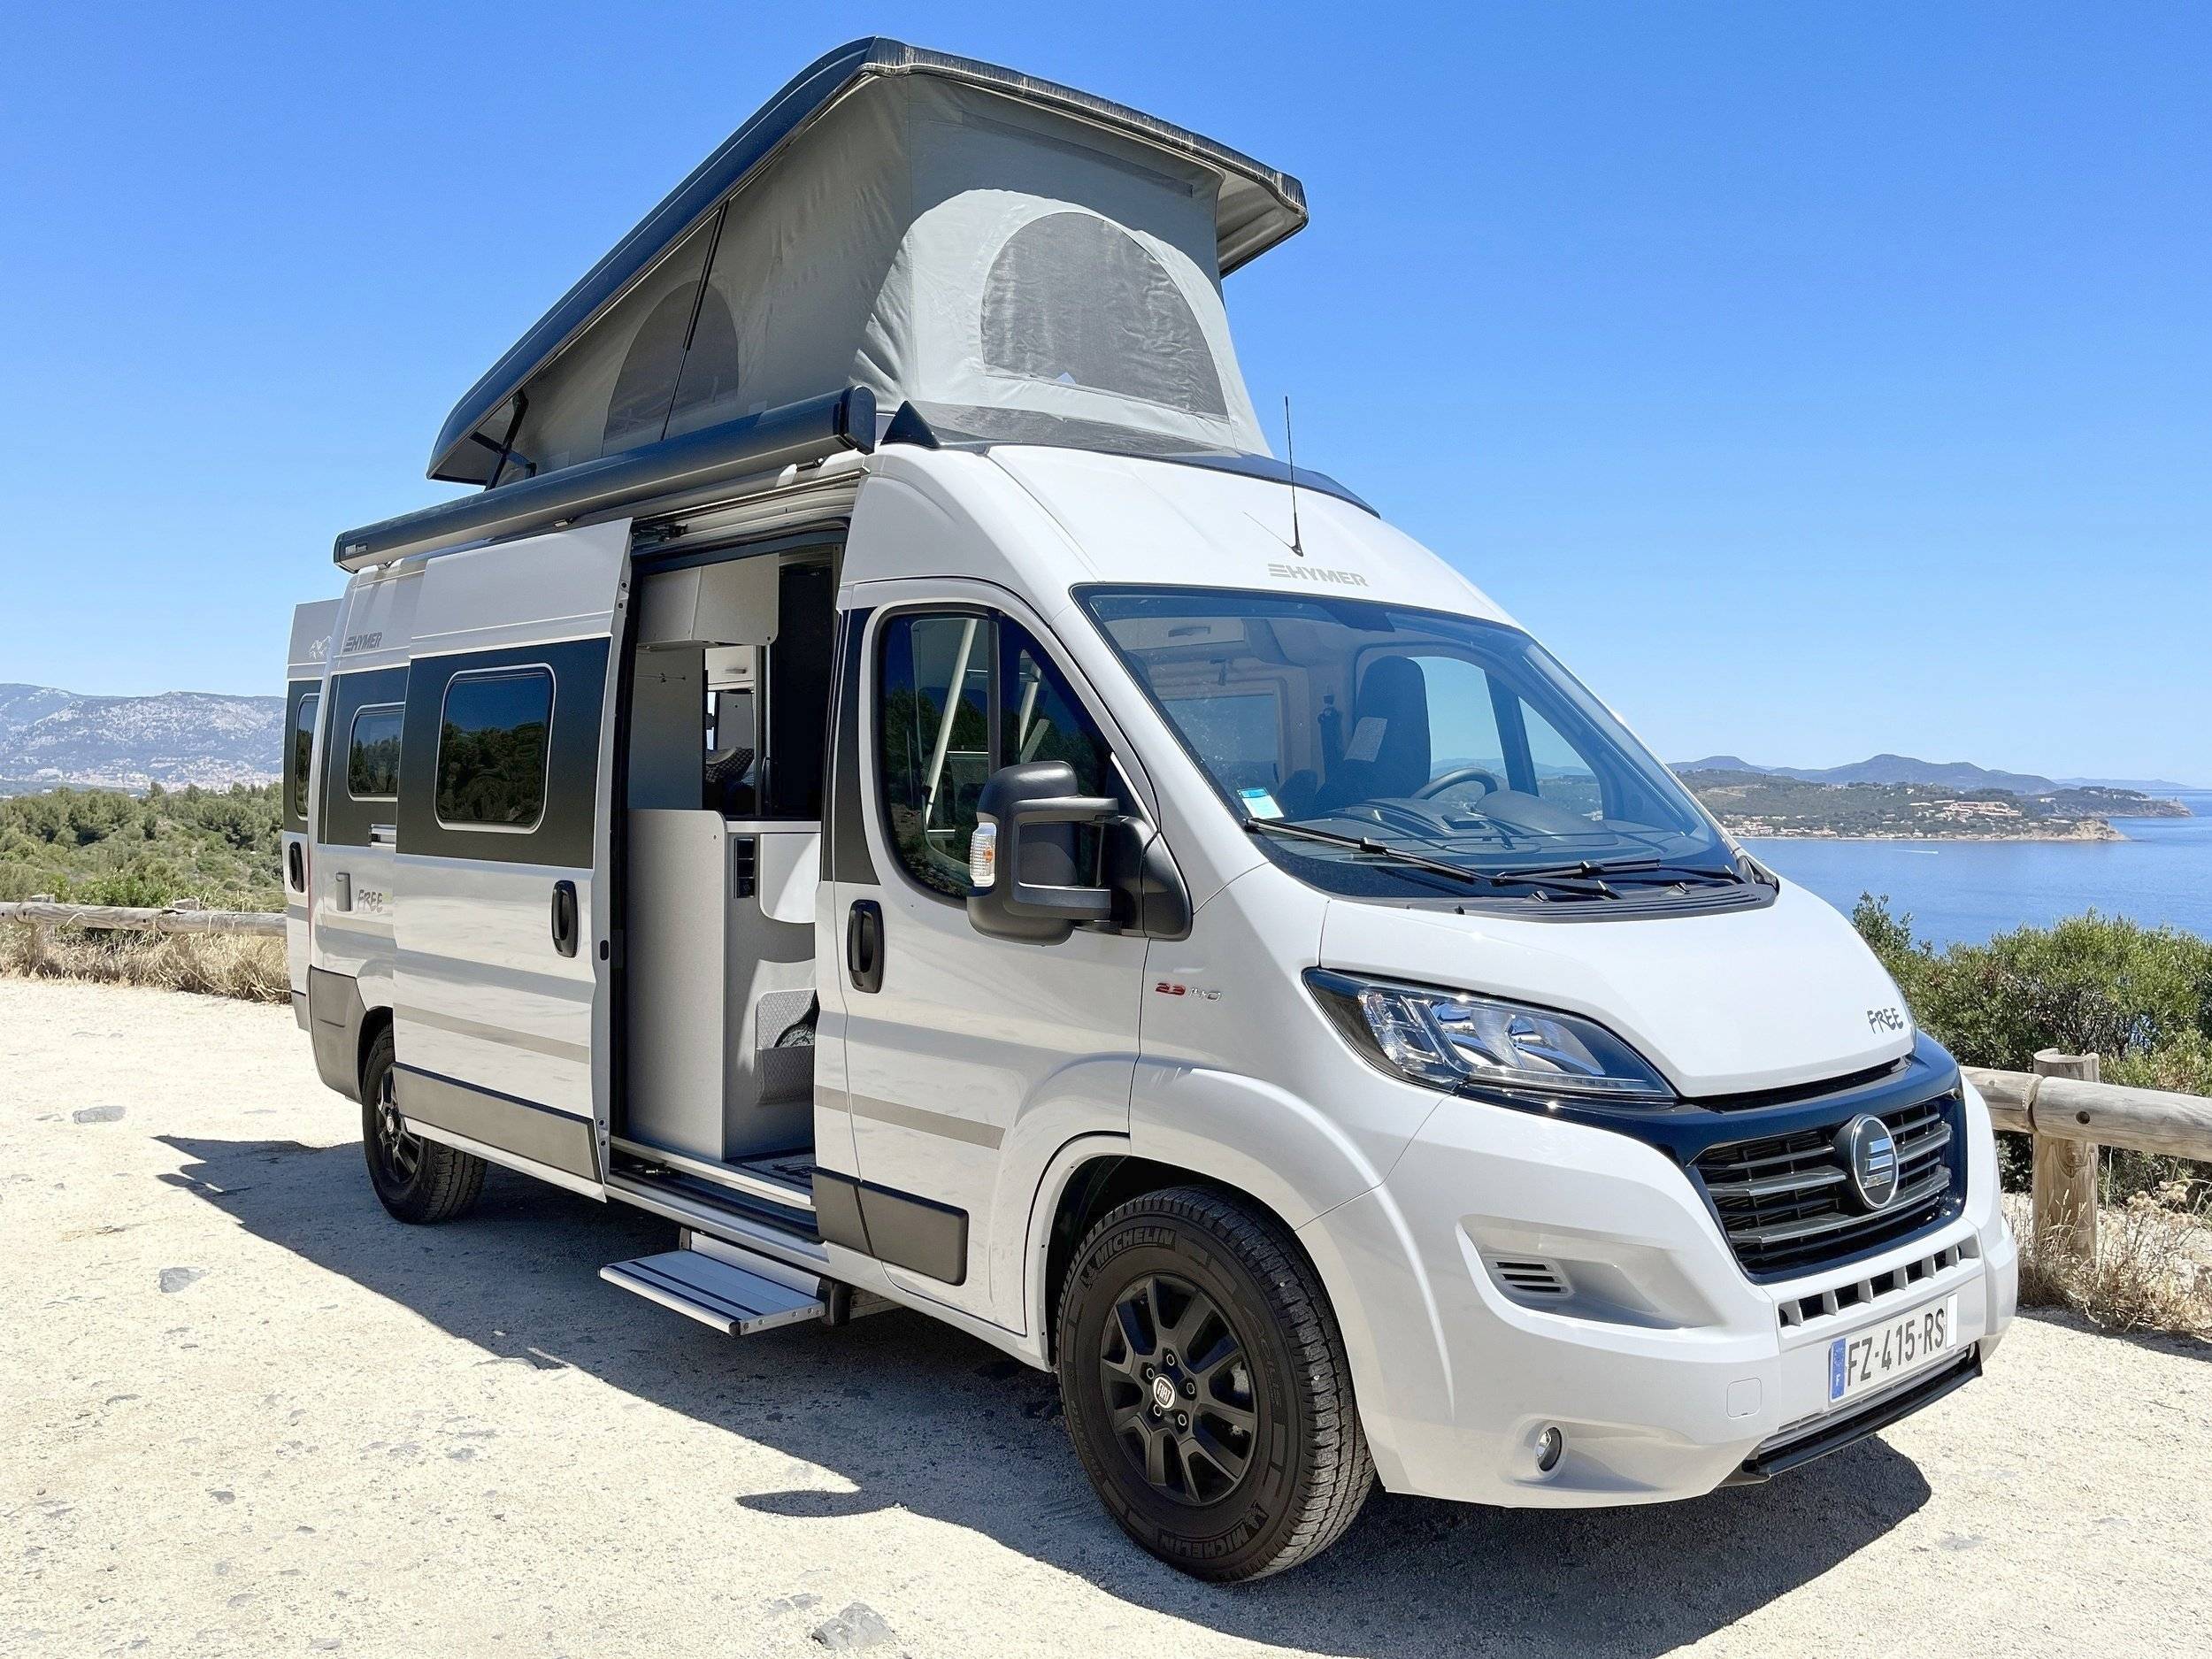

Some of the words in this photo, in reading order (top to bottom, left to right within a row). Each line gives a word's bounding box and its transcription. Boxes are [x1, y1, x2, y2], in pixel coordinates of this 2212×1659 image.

[1283, 565, 1369, 587] HYMER
[349, 632, 383, 651] HYMER
[357, 889, 383, 913] FREE
[1867, 1008, 1904, 1033] FREE
[1094, 1226, 1176, 1269] MICHELIN
[1835, 1373, 1841, 1386] F
[1847, 1308, 1945, 1386] FZ-415-RS
[1156, 1381, 1171, 1403] FIAT
[1159, 1522, 1251, 1558] MICHELIN
